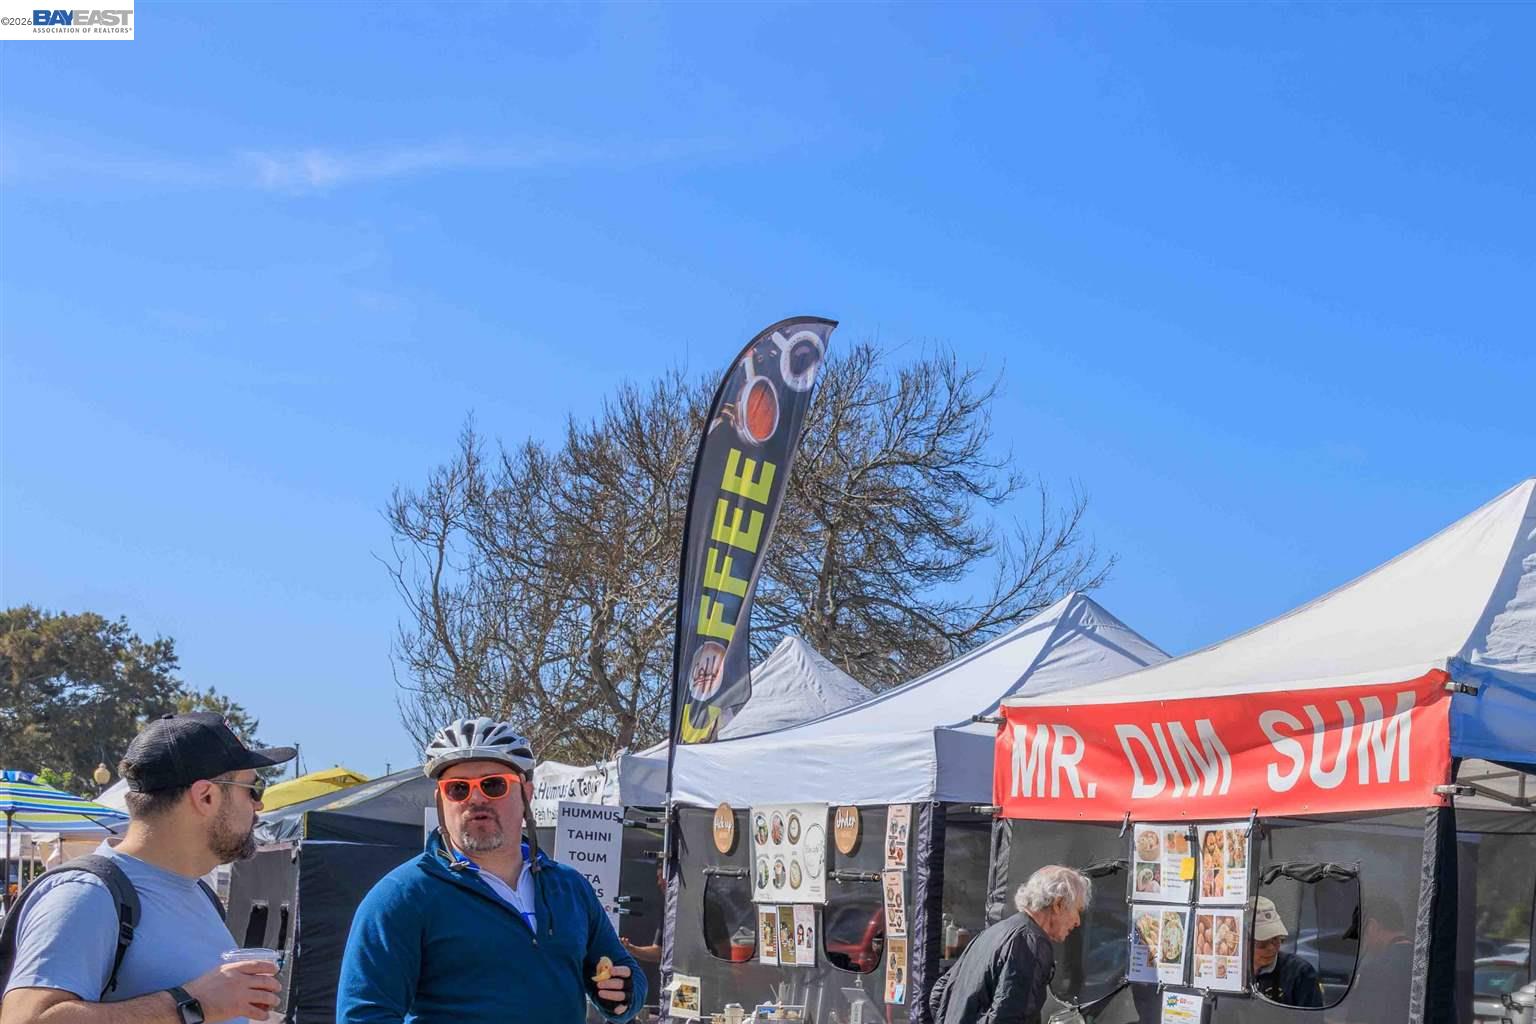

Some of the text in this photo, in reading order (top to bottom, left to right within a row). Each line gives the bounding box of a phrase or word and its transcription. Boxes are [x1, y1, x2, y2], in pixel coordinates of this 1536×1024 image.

[1010, 691, 1417, 800] MR. DIM SUM
[562, 807, 620, 822] HUMMUS
[567, 829, 612, 842] TAHINI
[568, 850, 607, 863] TOUM
